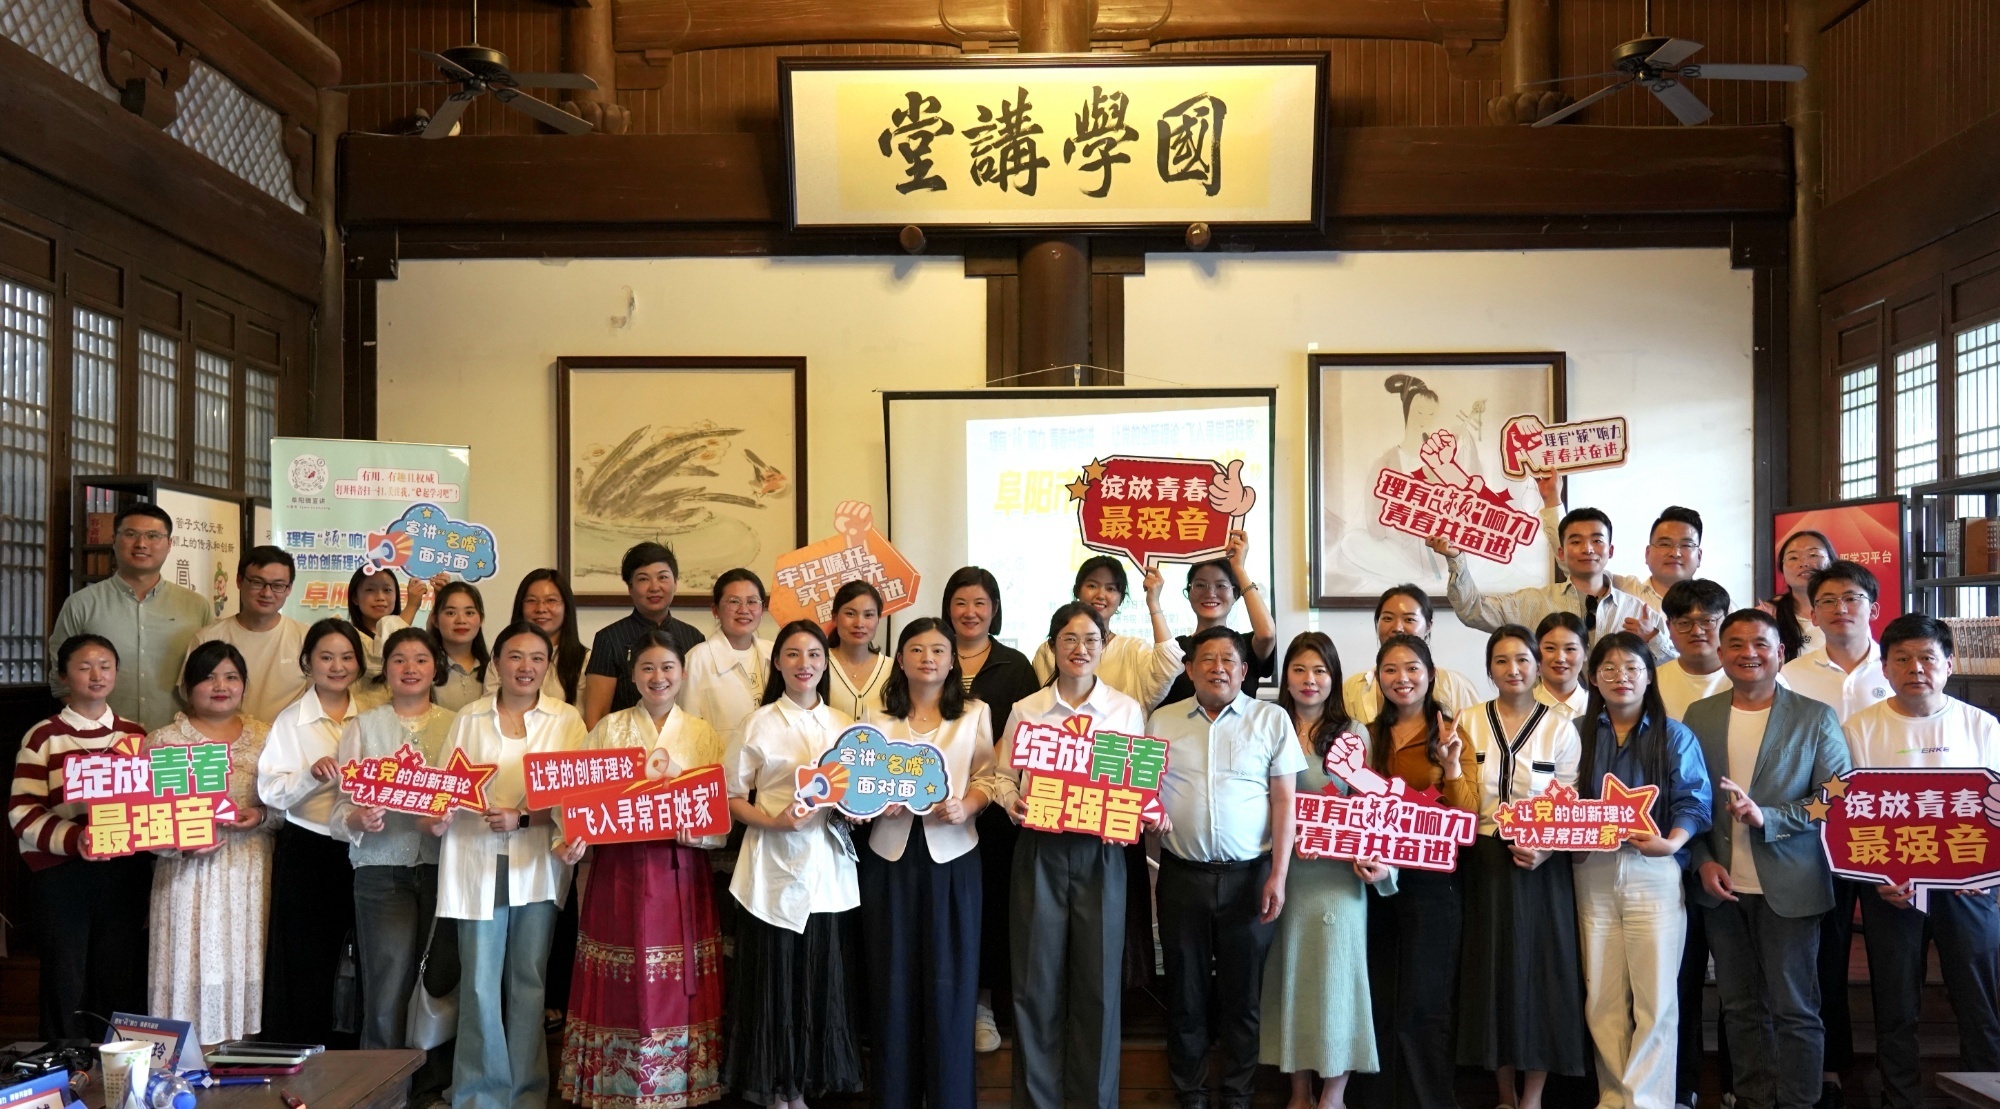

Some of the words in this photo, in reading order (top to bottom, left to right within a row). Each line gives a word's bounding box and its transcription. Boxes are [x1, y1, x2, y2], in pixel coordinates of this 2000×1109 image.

[1542, 441, 1619, 465] 青春共奋进
[1100, 474, 1208, 501] 绽放青春
[176, 517, 224, 535] 管子文化元素
[406, 519, 487, 553] 宣讲“名嘴”
[1099, 505, 1210, 542] 最强音
[1385, 502, 1511, 558] 青春共奋进
[419, 546, 470, 571] 面对面
[776, 545, 872, 588] 牢记嘱托
[65, 743, 231, 800] 绽放青春
[529, 756, 634, 792] 让党的创新理论
[839, 746, 935, 777] 宣讲“名嘴”
[1013, 724, 1168, 790] 绽放青春
[363, 761, 472, 794] 让党的创新理论
[857, 776, 917, 798] 面对面
[346, 782, 459, 812] “飞入寻常百姓家”
[567, 782, 719, 836] “飞入寻常百姓家”
[1024, 776, 1143, 840] 最强音
[1517, 800, 1636, 823] 让党的创新理论
[1844, 788, 1983, 820] 绽放青春
[89, 797, 214, 854] 最强音
[1504, 825, 1627, 846] “飞入寻常百姓家”
[1305, 826, 1452, 865] 青春共奋进
[1846, 823, 1990, 866] 最强音
